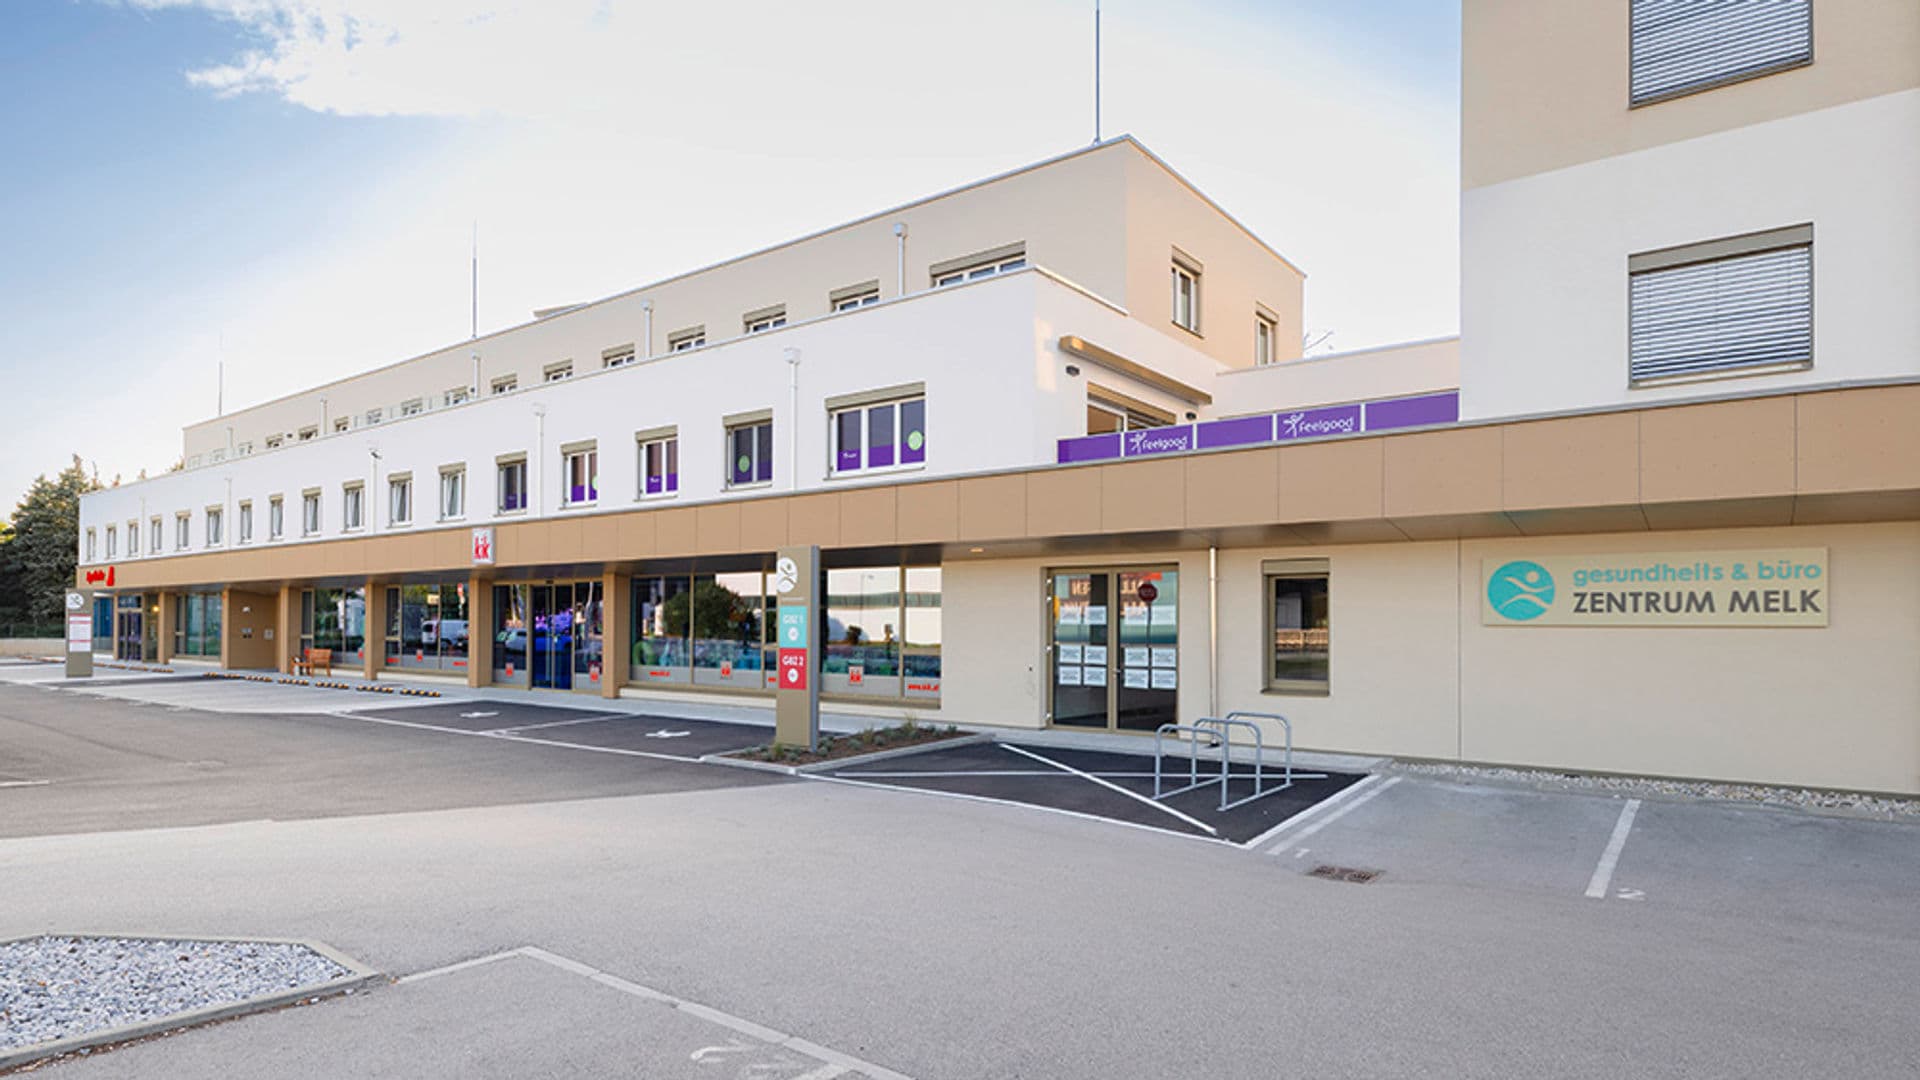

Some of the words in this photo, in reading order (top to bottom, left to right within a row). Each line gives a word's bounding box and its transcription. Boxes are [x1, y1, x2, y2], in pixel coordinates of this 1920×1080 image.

[1573, 562, 1723, 587] gesundheits
[1731, 563, 1748, 580] &
[1758, 560, 1822, 579] büro
[1573, 591, 1715, 613] ZENTRUM
[1729, 590, 1821, 613] MELK
